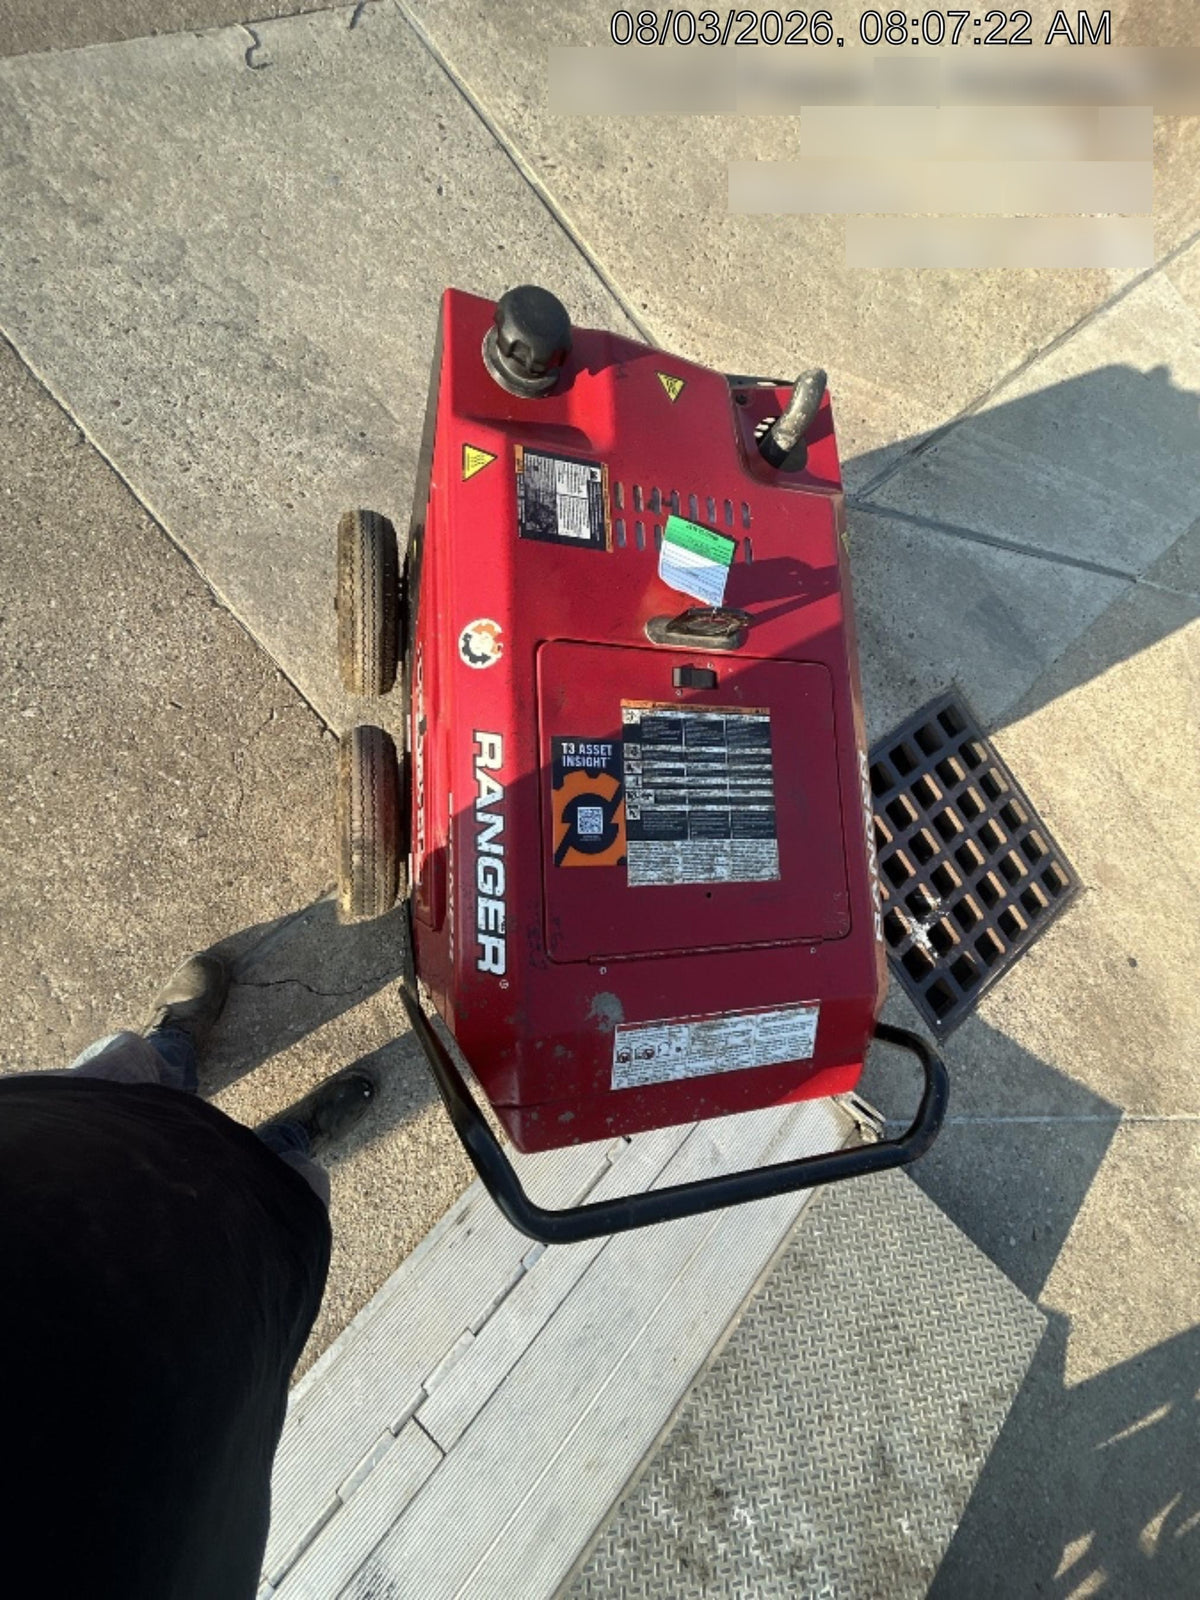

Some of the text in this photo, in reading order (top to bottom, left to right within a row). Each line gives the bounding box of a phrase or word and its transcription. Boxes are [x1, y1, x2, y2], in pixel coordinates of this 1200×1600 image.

[561, 742, 612, 756] T3 ASSET
[562, 755, 606, 768] INSIGHT
[473, 730, 507, 976] RANGER
